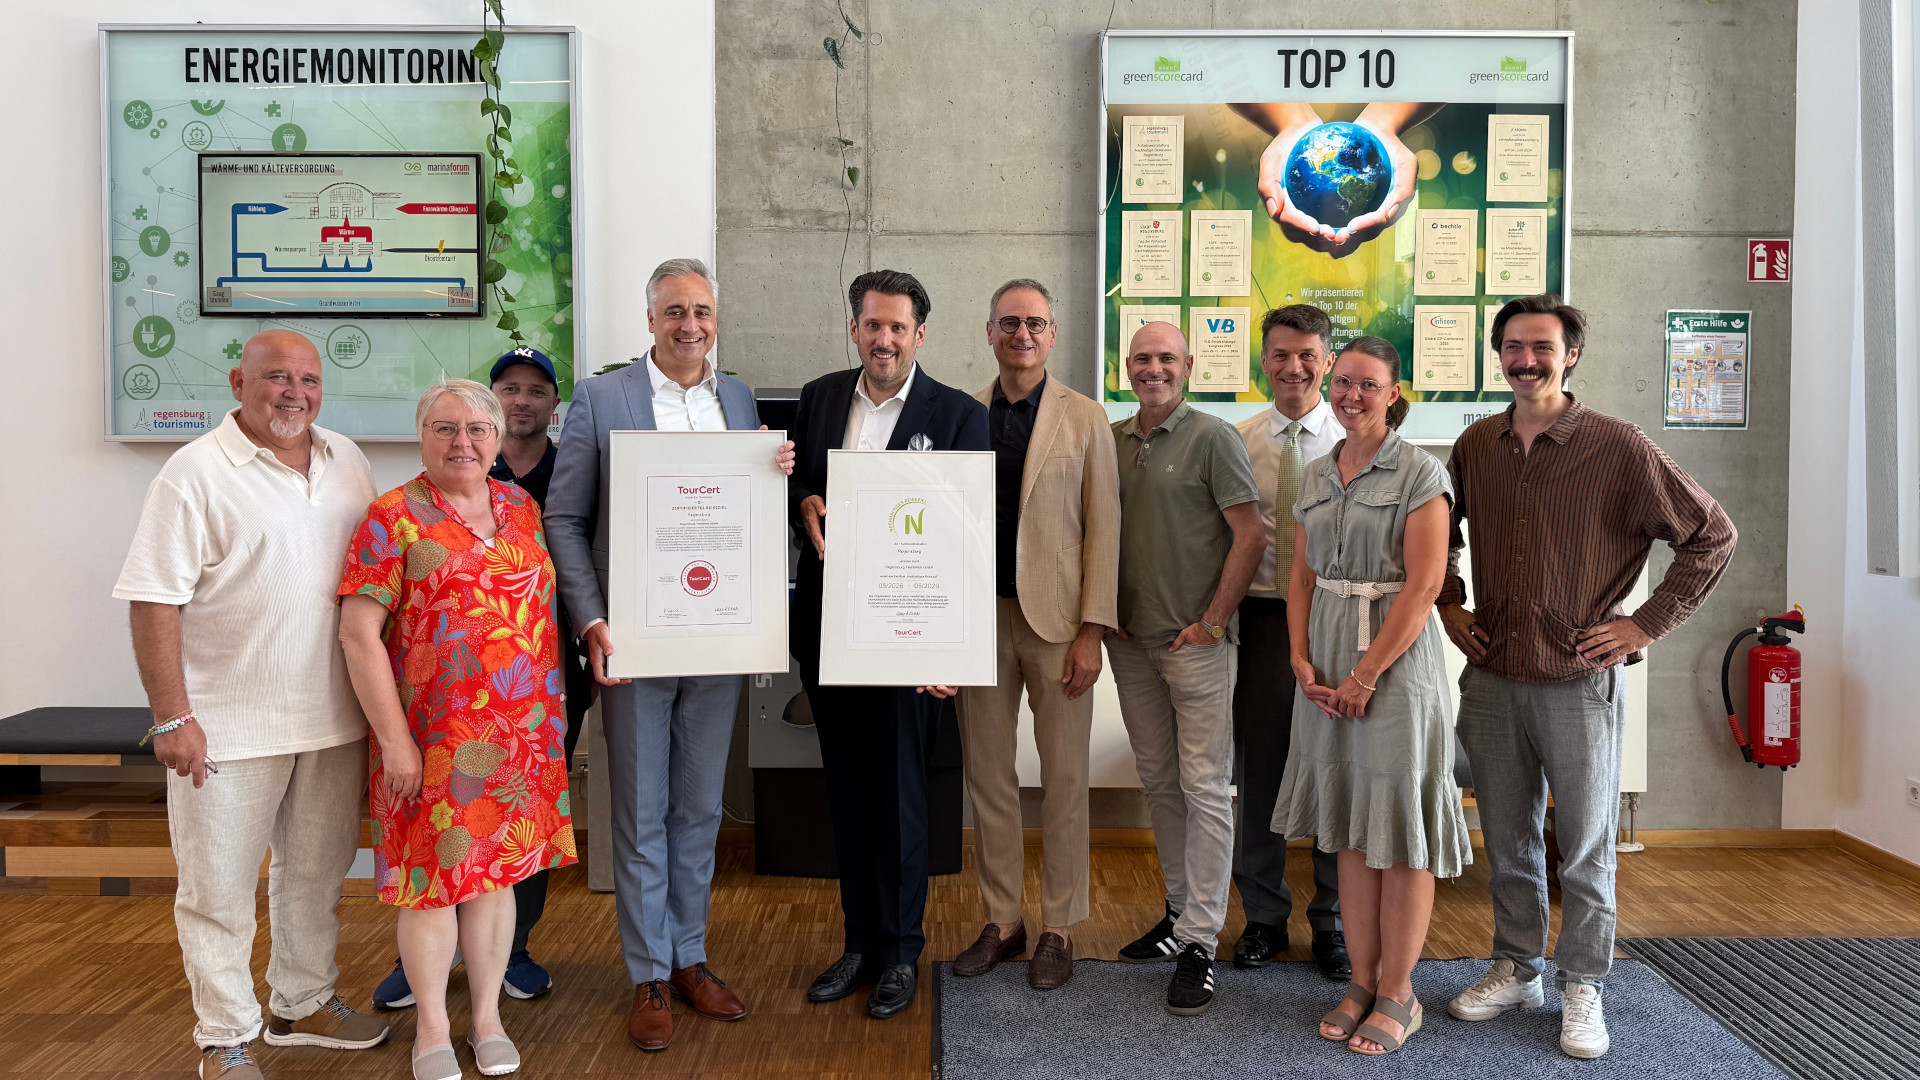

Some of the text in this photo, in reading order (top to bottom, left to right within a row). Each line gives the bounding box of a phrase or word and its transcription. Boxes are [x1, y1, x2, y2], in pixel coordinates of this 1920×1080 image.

[185, 47, 488, 84] ENERGIEMONITORIN
[1277, 48, 1396, 89] TOP 10
[1123, 71, 1203, 85] greenscorecard
[1469, 71, 1549, 85] greenscorecard
[211, 163, 336, 174] WÄRME- UND KÄLTEVERSORGUNG
[427, 162, 470, 172] marinaforum
[1300, 287, 1364, 299] Wir präsentieren
[1319, 300, 1332, 311] Top
[1334, 300, 1344, 310] 10
[1345, 301, 1358, 310] der
[1328, 314, 1356, 325] altigen
[1709, 319, 1728, 327] Hilfe
[1331, 327, 1363, 339] ltungen
[152, 409, 206, 420] regensburg
[152, 419, 206, 429] tourismus
[677, 485, 721, 494] TourCert
